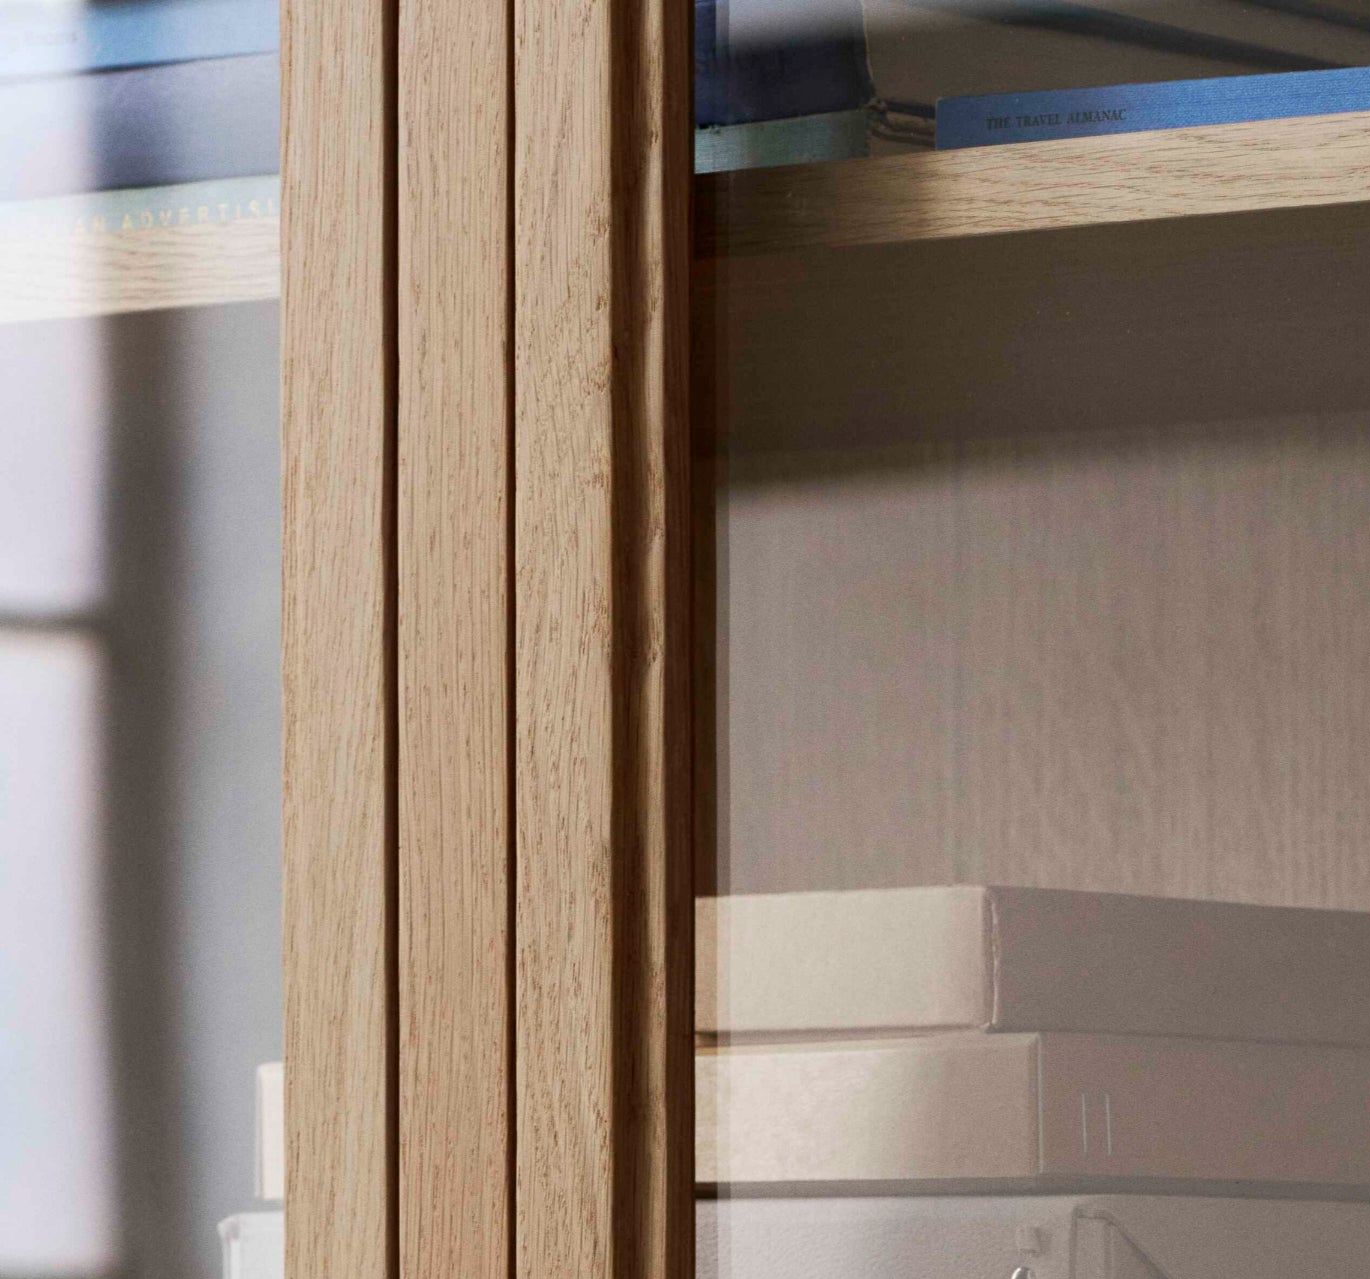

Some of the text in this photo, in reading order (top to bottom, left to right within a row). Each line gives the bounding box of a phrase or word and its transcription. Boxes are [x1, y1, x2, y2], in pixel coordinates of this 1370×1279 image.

[985, 108, 1127, 130] THE TRAVEL ALMANAC
